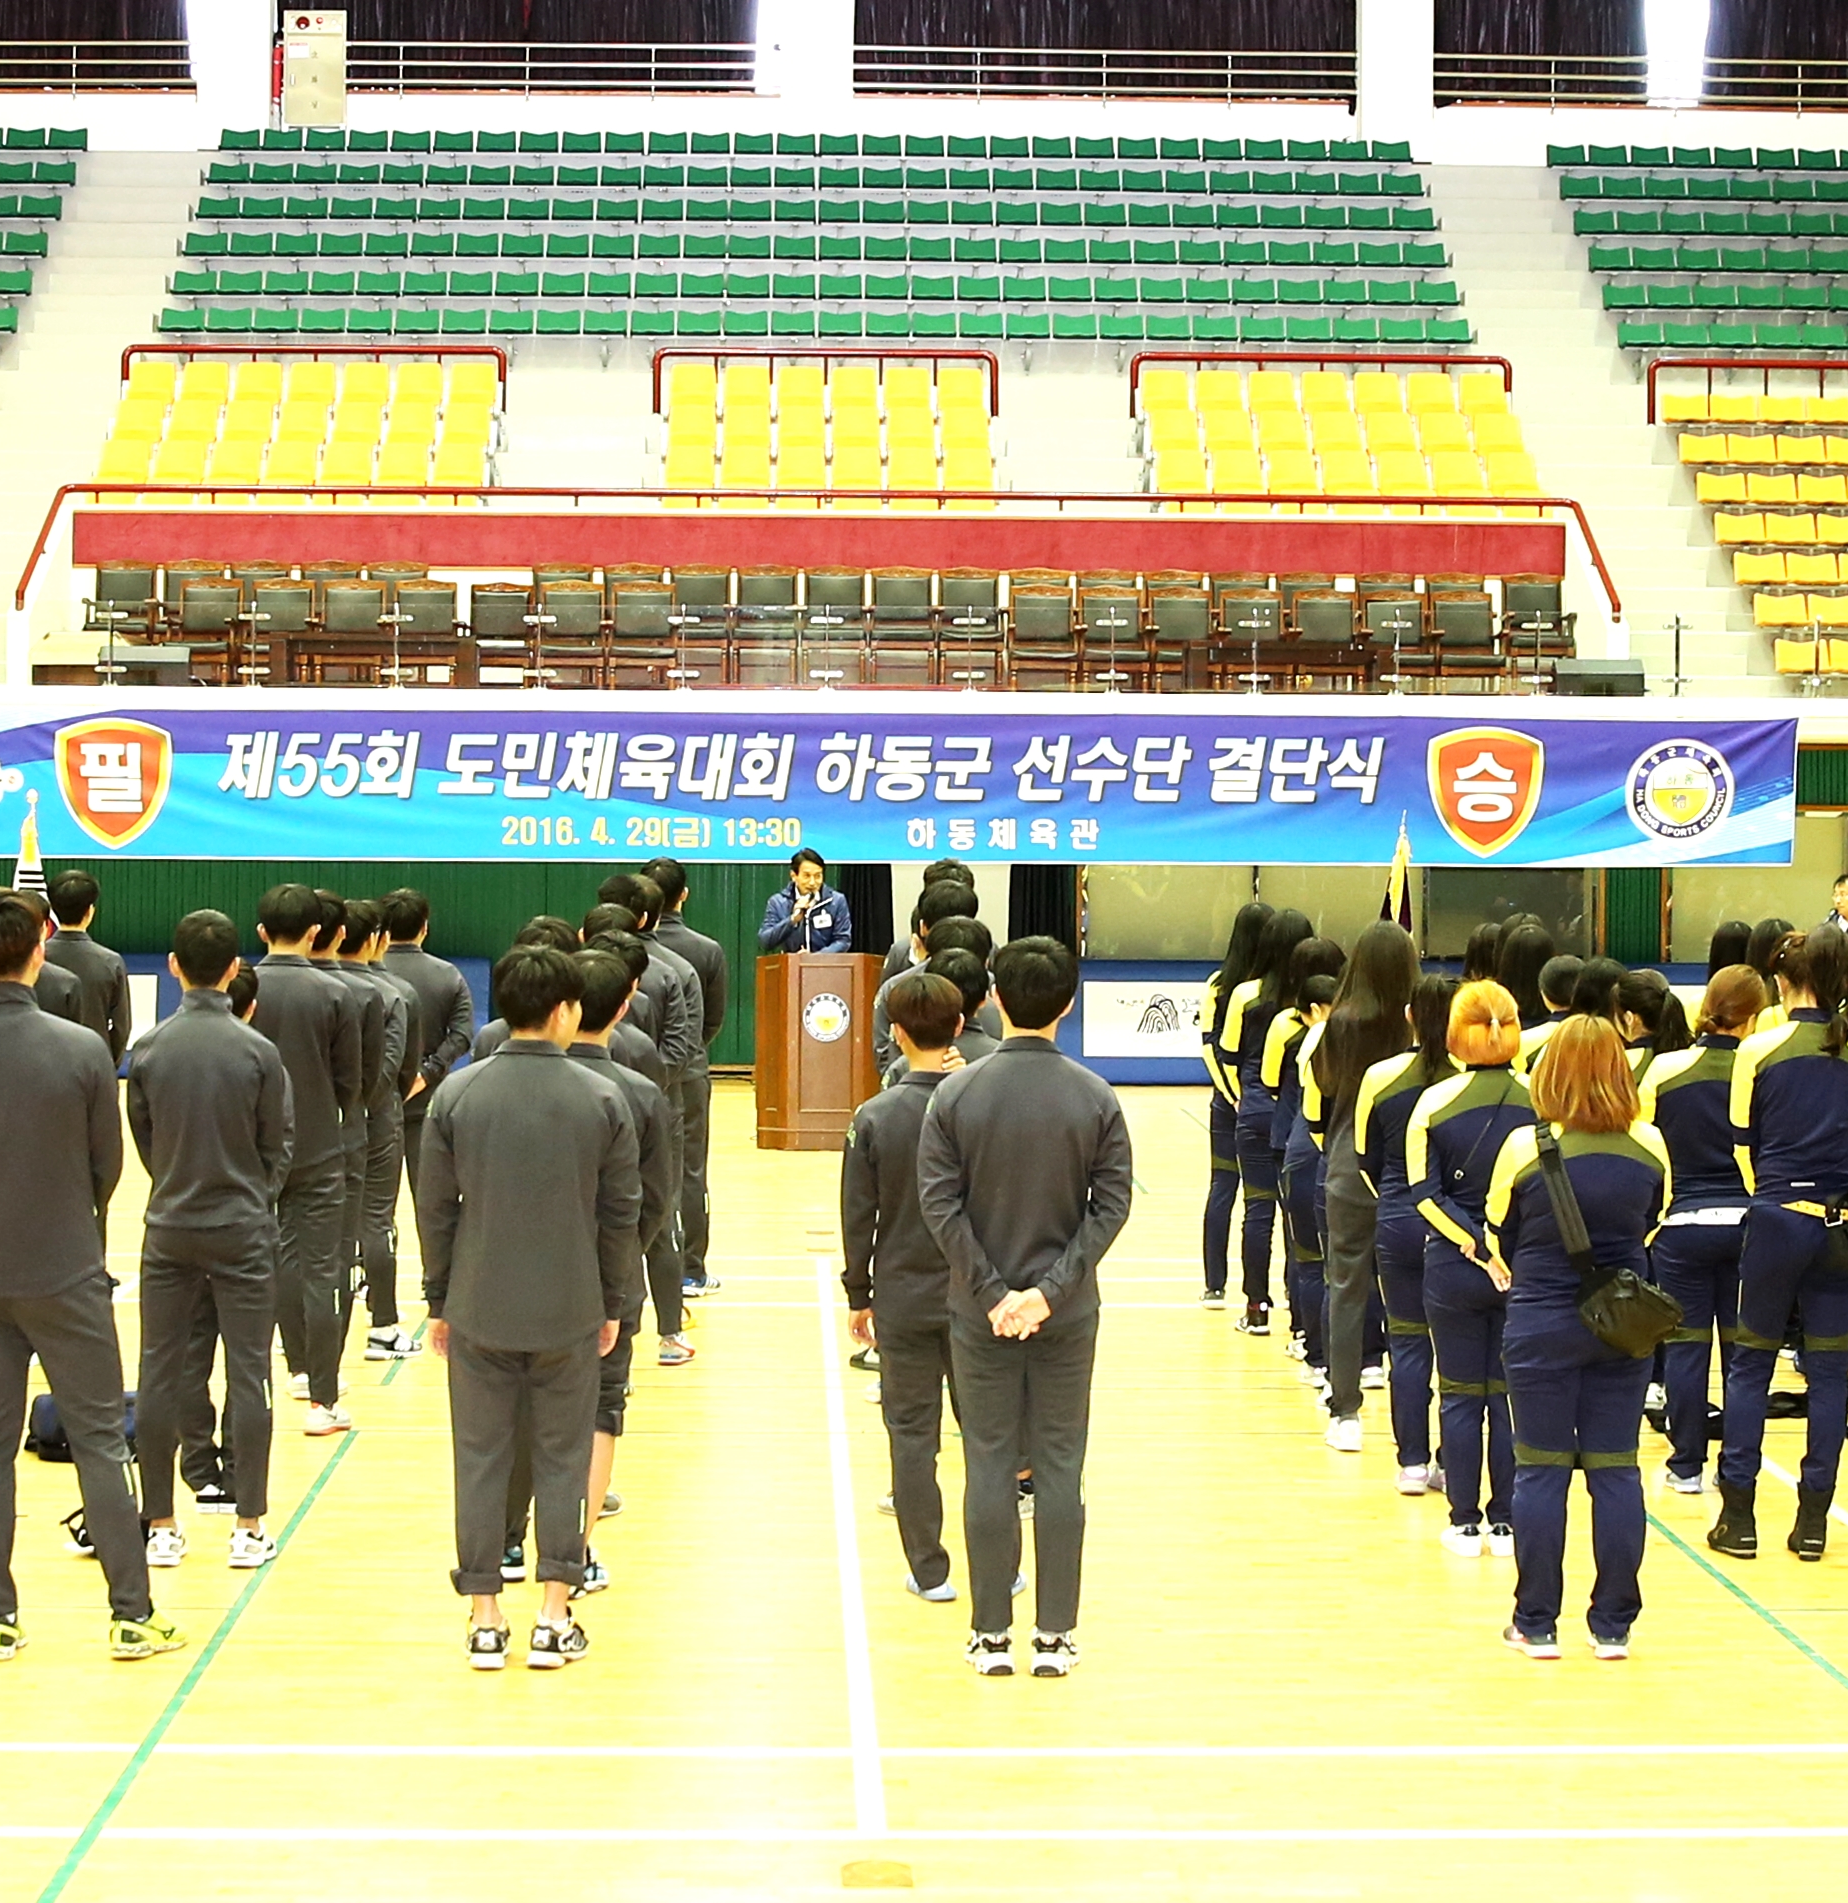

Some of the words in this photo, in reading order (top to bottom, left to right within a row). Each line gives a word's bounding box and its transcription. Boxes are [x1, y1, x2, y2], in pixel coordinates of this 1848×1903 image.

[79, 741, 143, 813] 필
[217, 730, 421, 799] 제55회
[437, 731, 796, 800] 도민체육대회
[815, 732, 993, 801] 하동군
[1012, 735, 1193, 803] 선수단
[1209, 736, 1385, 804] 결단식
[1453, 751, 1517, 822] 승
[501, 816, 581, 846] 2016.
[590, 816, 616, 846] 4.
[626, 816, 710, 849] 29(금)
[723, 817, 802, 847] 13:30
[906, 817, 1100, 851] 하동체육관
[1660, 824, 1701, 838] SPORTS
[1699, 787, 1726, 828] COUNCIL
